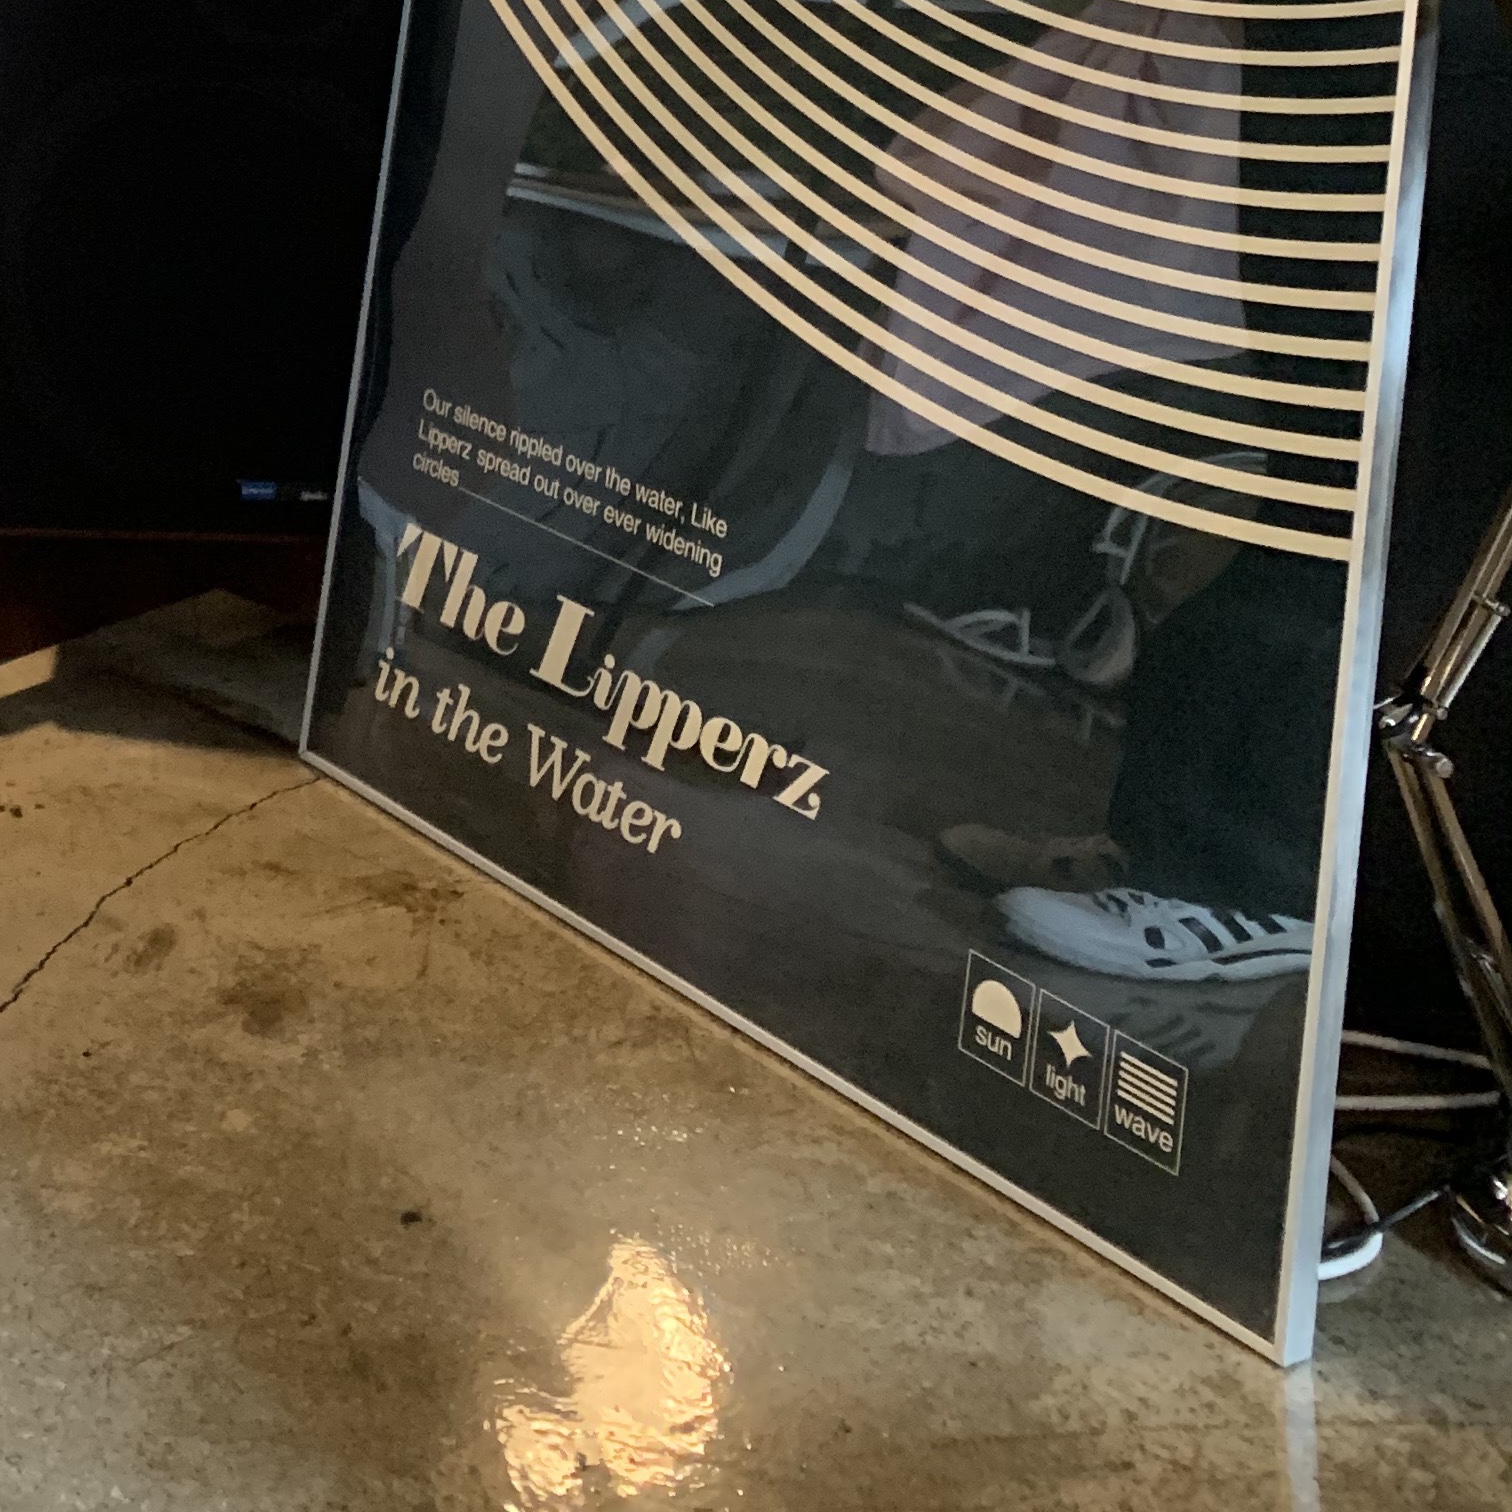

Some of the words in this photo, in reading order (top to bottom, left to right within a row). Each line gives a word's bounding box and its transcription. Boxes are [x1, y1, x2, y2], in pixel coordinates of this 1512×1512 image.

[413, 451, 460, 487] circles
[418, 418, 473, 460] Lipperz
[476, 448, 531, 486] spread
[533, 474, 561, 500] out
[563, 487, 601, 517] over
[604, 505, 642, 535] ever
[645, 523, 723, 578] widening
[423, 388, 452, 418] Our
[453, 404, 507, 441] silence
[510, 427, 563, 467] rippled
[565, 454, 602, 483] over
[605, 465, 631, 496] the
[635, 483, 685, 525] water,
[690, 502, 728, 538] Like
[396, 522, 527, 656] The
[529, 594, 830, 821] Lipperz
[373, 647, 420, 720] in
[431, 683, 510, 764] the
[526, 723, 683, 854] Water
[975, 1024, 1013, 1061] sun
[1045, 1063, 1087, 1107] light
[1114, 1103, 1174, 1153] wave
